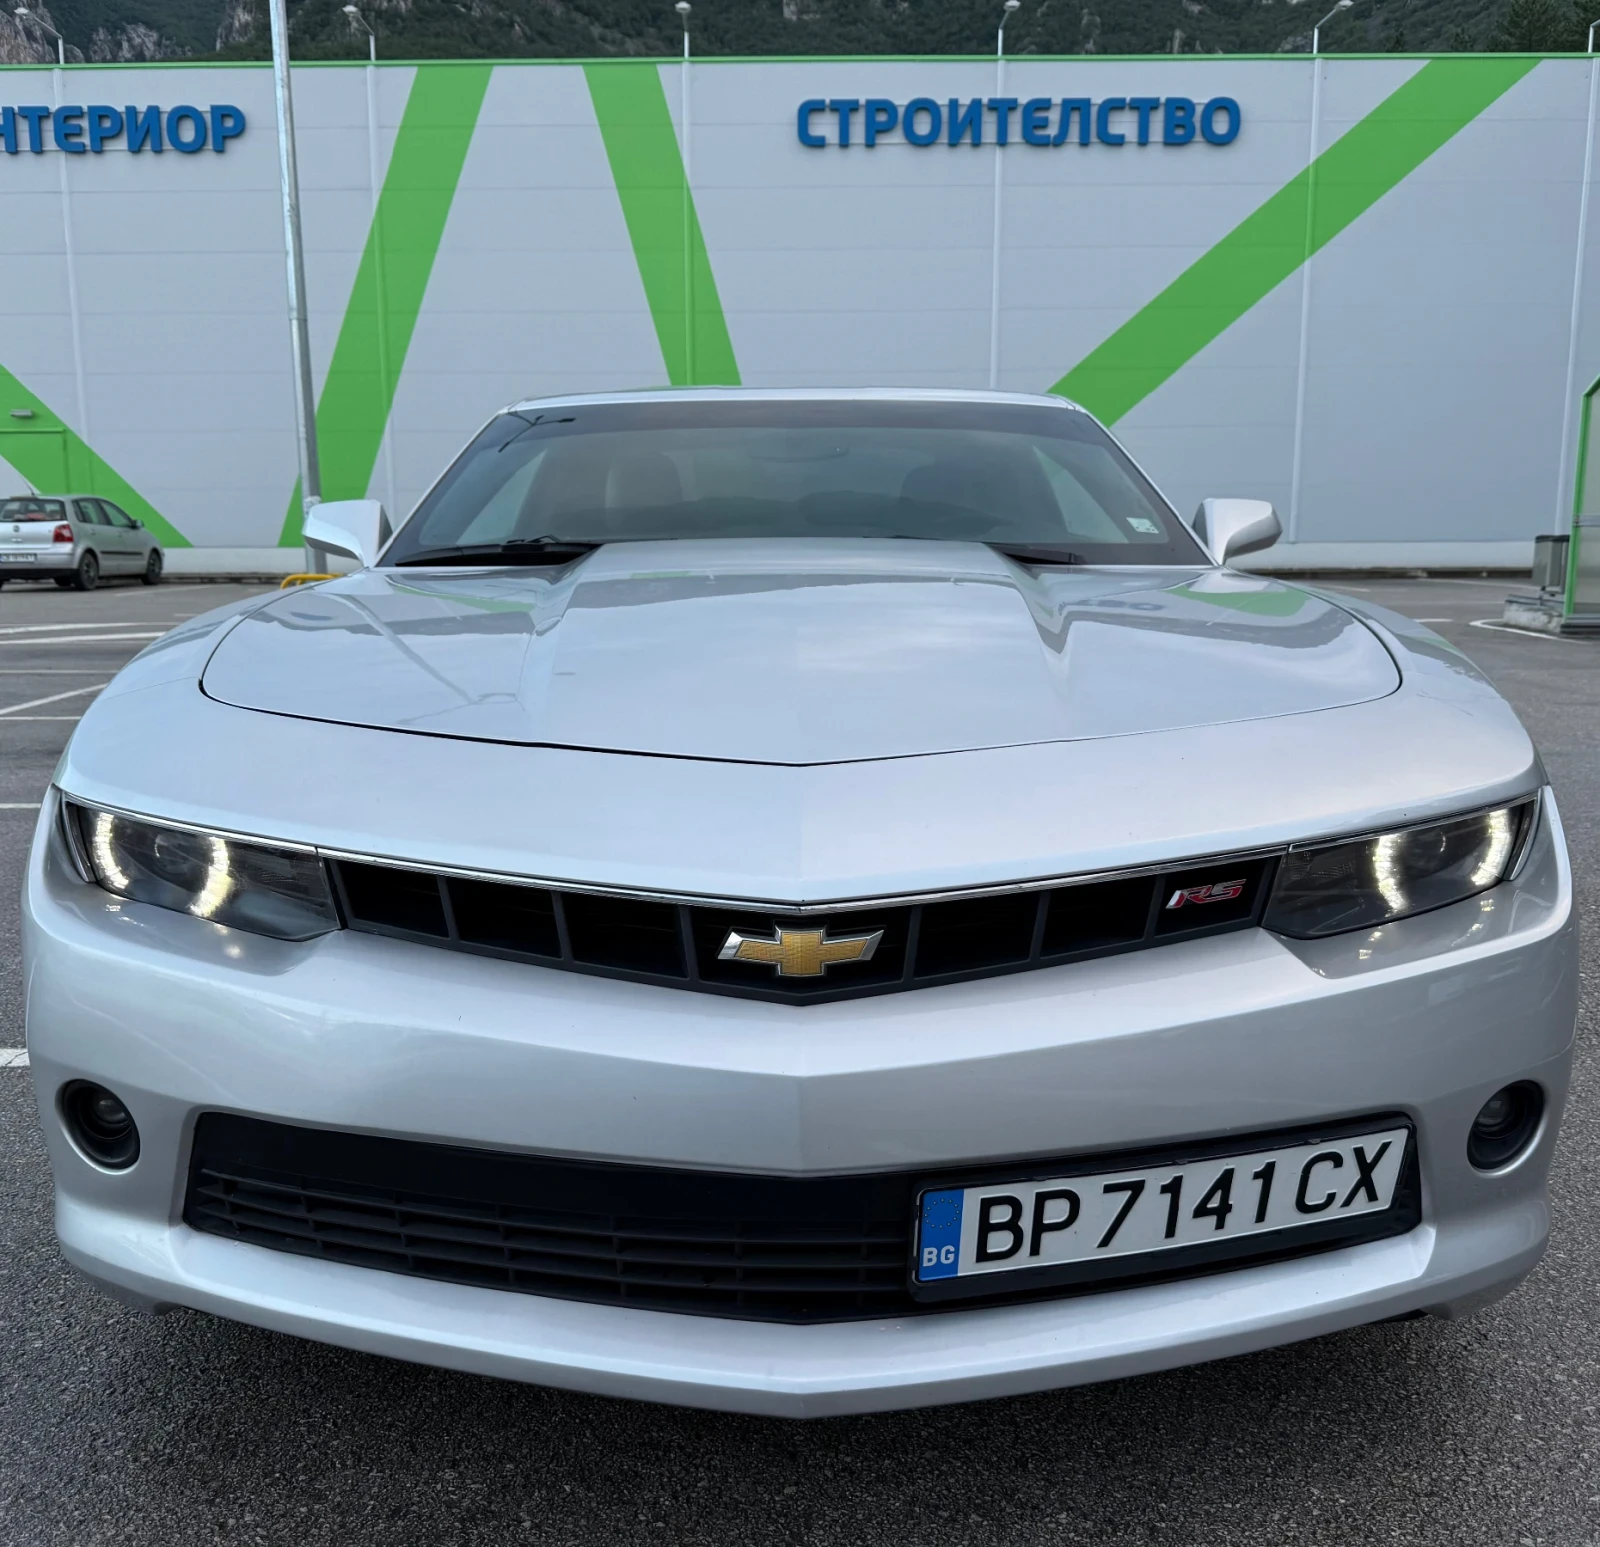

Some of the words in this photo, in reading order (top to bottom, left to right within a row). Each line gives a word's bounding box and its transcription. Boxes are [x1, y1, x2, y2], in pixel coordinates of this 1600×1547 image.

[797, 97, 1241, 147] СТРОИТЕЛСТВО
[1165, 879, 1247, 909] RS
[976, 1190, 1081, 1264] BP
[1097, 1159, 1277, 1248] 7141
[1295, 1140, 1393, 1214] CX
[922, 1244, 956, 1268] BG
